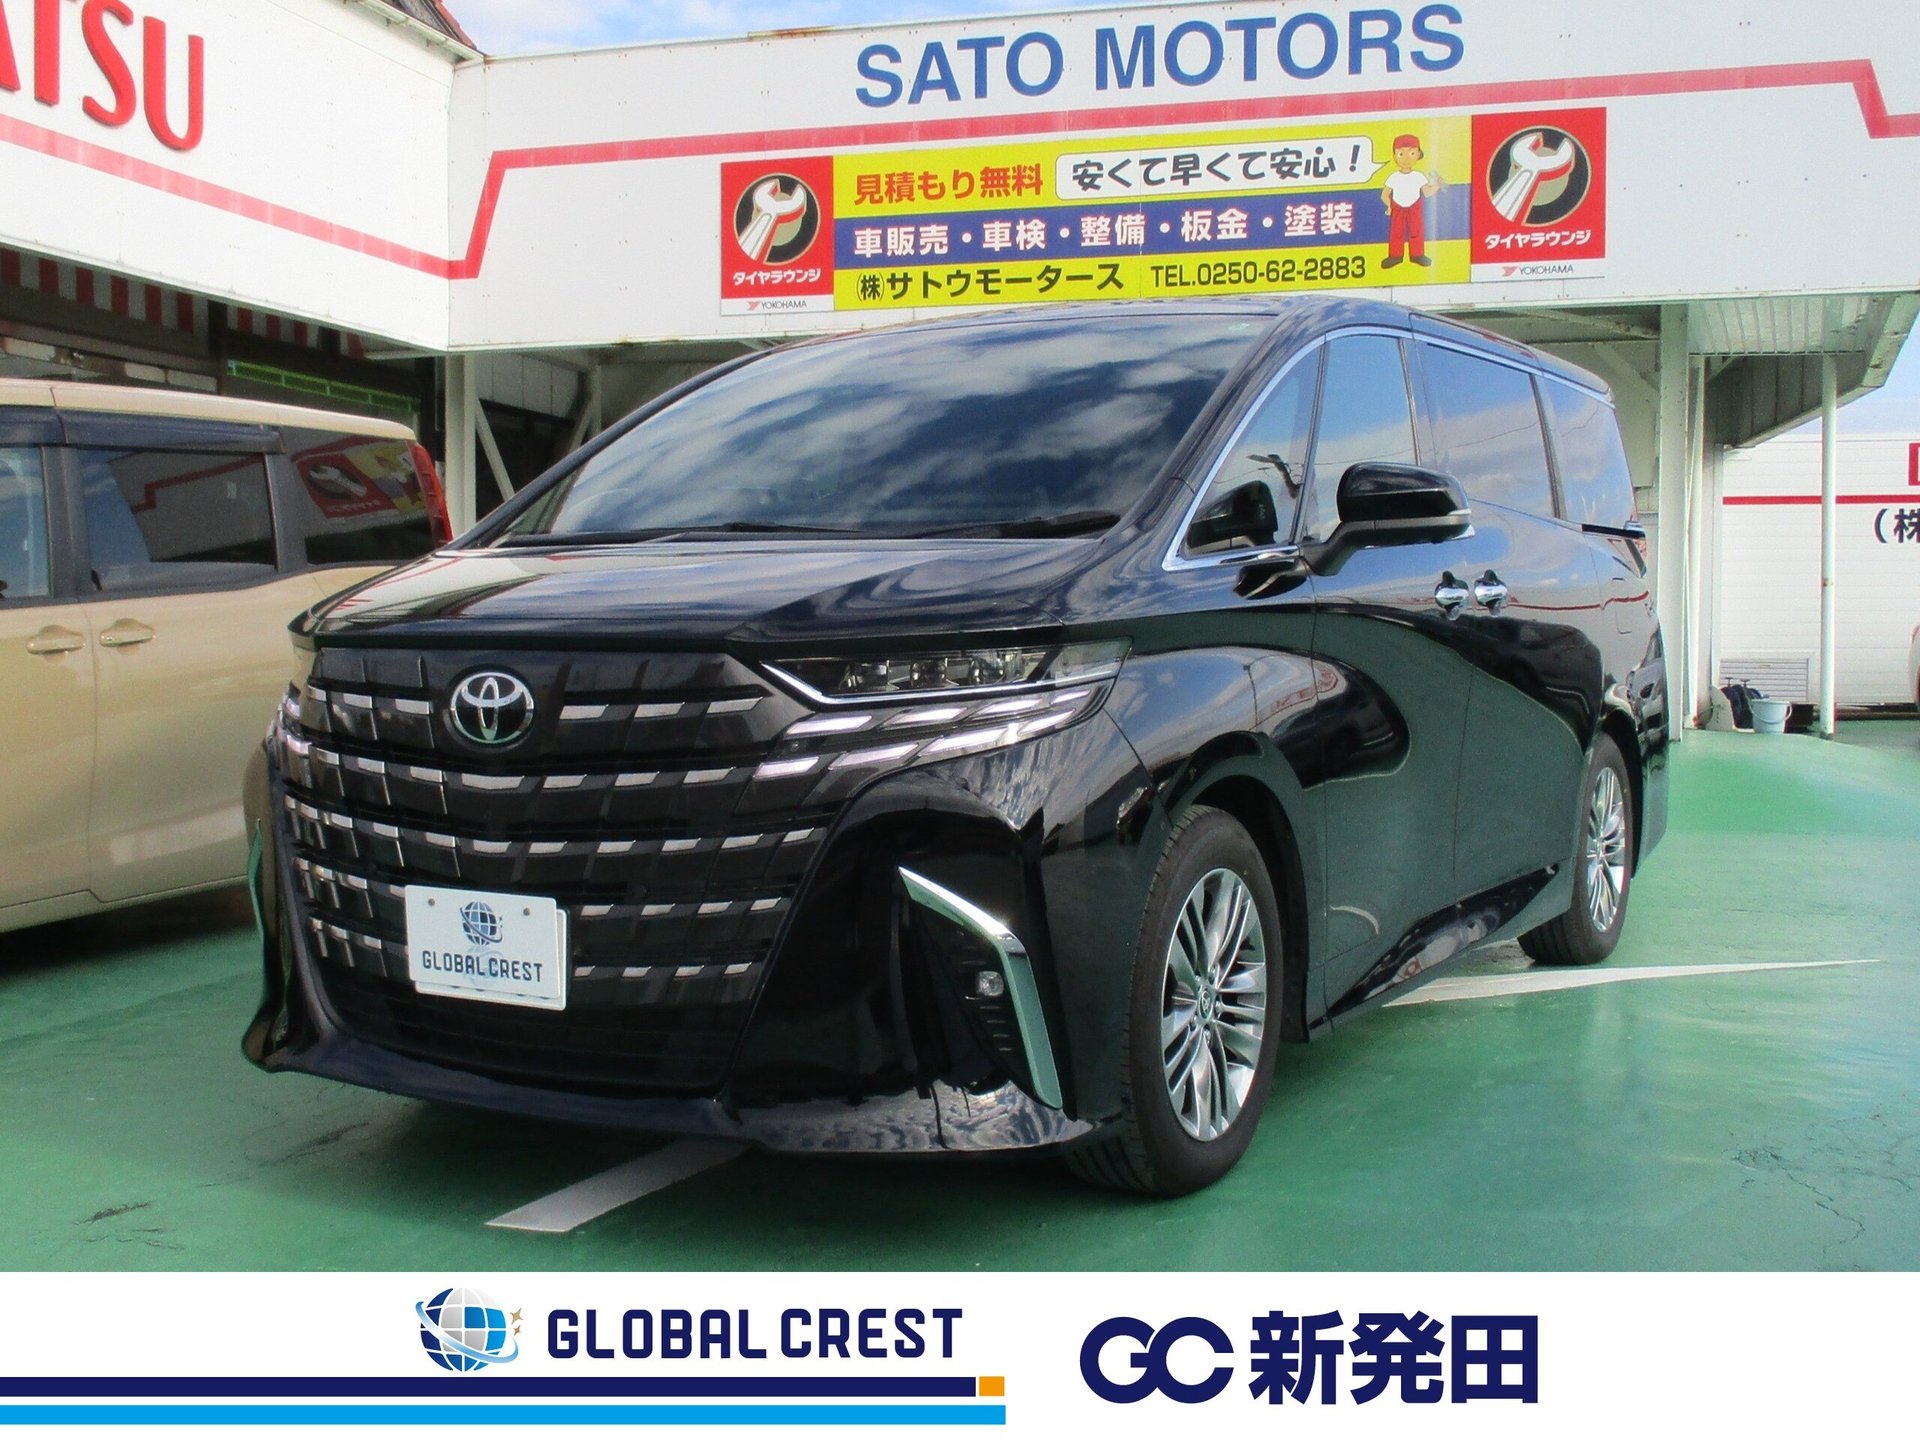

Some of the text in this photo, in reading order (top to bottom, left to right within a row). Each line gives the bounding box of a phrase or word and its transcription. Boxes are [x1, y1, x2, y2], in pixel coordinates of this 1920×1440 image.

[855, 4, 1464, 107] SATO MOTORS
[854, 163, 1043, 206] 見積もり無料
[1485, 229, 1592, 250] タイヤラウンジ
[733, 268, 821, 286] タイヤラウンジ
[1519, 264, 1574, 275] YOKOHAMA
[762, 300, 807, 310] YOKOHAMA
[422, 950, 543, 983] GLOBAL CREST
